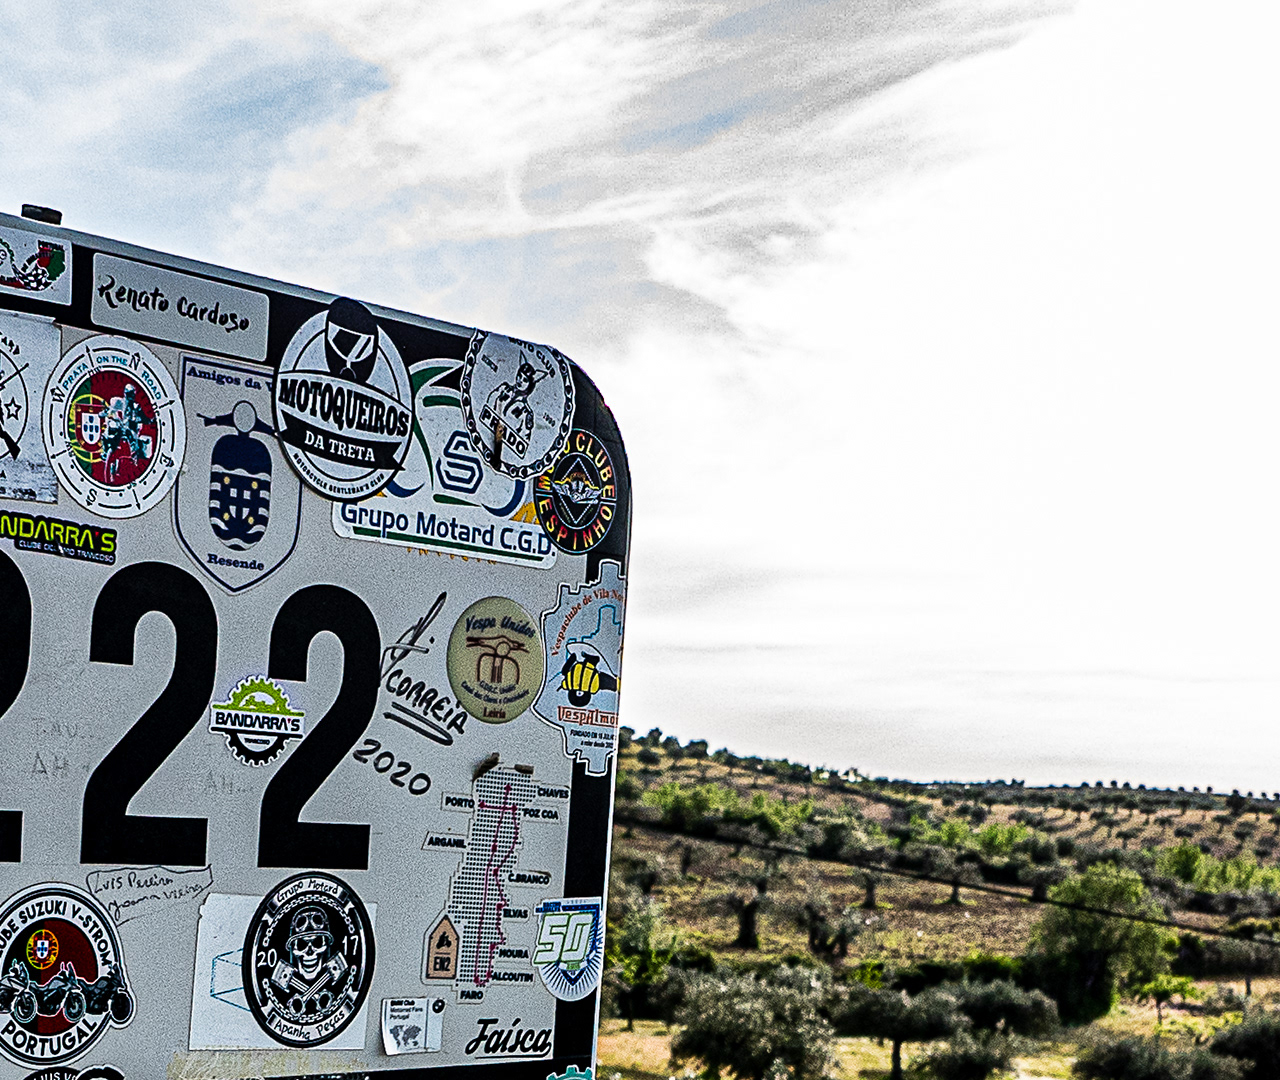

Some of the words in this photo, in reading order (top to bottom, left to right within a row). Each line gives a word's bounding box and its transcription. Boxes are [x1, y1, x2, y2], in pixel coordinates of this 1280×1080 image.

[96, 273, 170, 314] Renato
[175, 297, 250, 334] Cardoso
[62, 362, 90, 390] PRATA
[96, 355, 110, 365] ON
[111, 355, 128, 367] THE
[141, 370, 163, 400] ROAD
[186, 365, 241, 387] Amigos
[243, 372, 263, 390] da
[277, 377, 411, 438] MOTOQUEIROS
[304, 430, 325, 450] DA
[328, 438, 376, 462] TRETA
[340, 502, 410, 538] Grupo
[414, 510, 495, 547] Motard
[499, 527, 557, 558] C.G.D.
[206, 552, 266, 573] Resende
[465, 615, 495, 633] Vespa
[500, 615, 536, 639] Unidos
[215, 711, 301, 732] BANDARRA'S
[352, 738, 433, 796] 2020
[445, 796, 476, 809] PORTO
[537, 786, 570, 800] CHAVES
[276, 886, 306, 905] Grupo
[503, 907, 530, 920] ELVAS
[18, 901, 69, 930] SUZUKI
[70, 902, 116, 967] V-STROM
[533, 912, 596, 965] 50
[340, 935, 359, 957] 17
[498, 948, 529, 960] MOURA
[256, 948, 278, 969] 20
[491, 971, 534, 983] ALCOUTIM
[459, 990, 484, 1001] FARO
[0, 1016, 99, 1057] PORTUGAL
